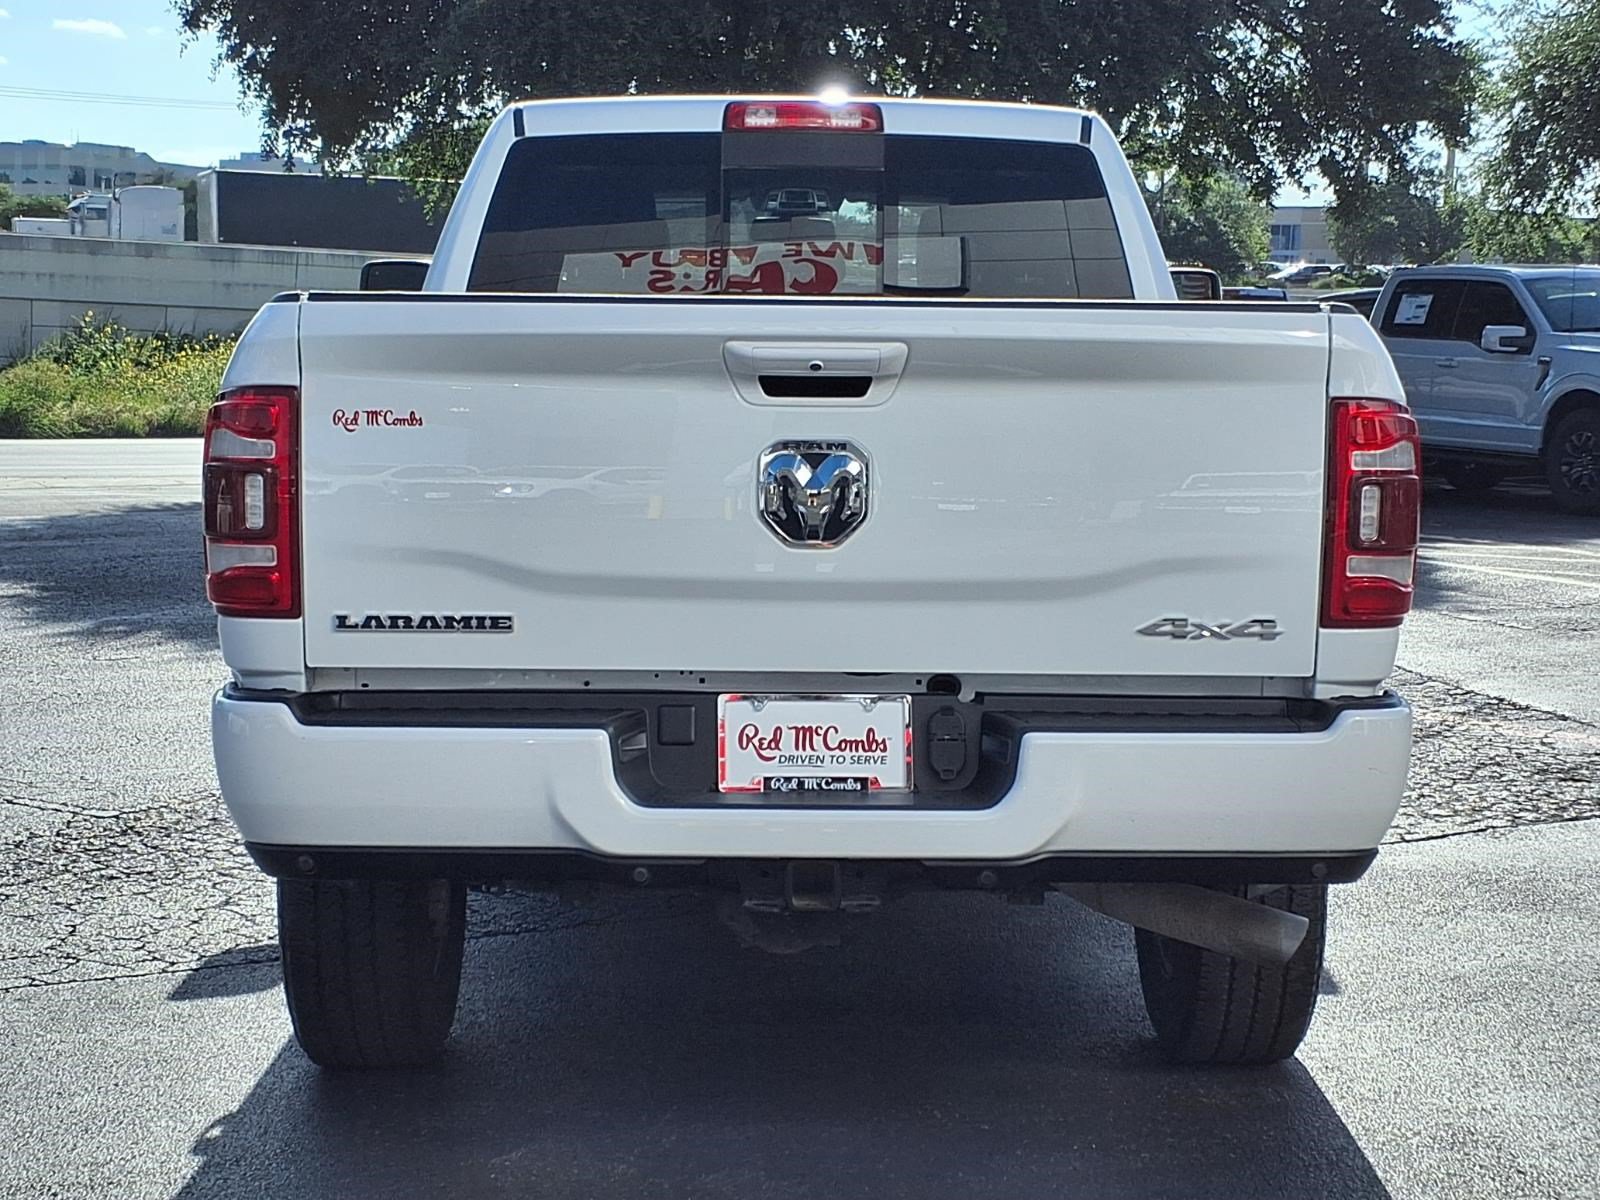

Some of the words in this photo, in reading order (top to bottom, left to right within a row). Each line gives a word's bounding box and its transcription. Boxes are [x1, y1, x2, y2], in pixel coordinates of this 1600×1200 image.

[332, 409, 359, 432] Red
[362, 409, 423, 426] McCombs
[782, 441, 848, 451] RAM
[334, 614, 514, 633] LARAMIE
[738, 723, 783, 761] Red
[787, 725, 888, 753] McCombs
[778, 754, 825, 765] DRIVEN
[829, 754, 846, 765] TO
[849, 754, 888, 765] SERVE
[770, 777, 799, 791] Red
[800, 777, 861, 791] McCombs
